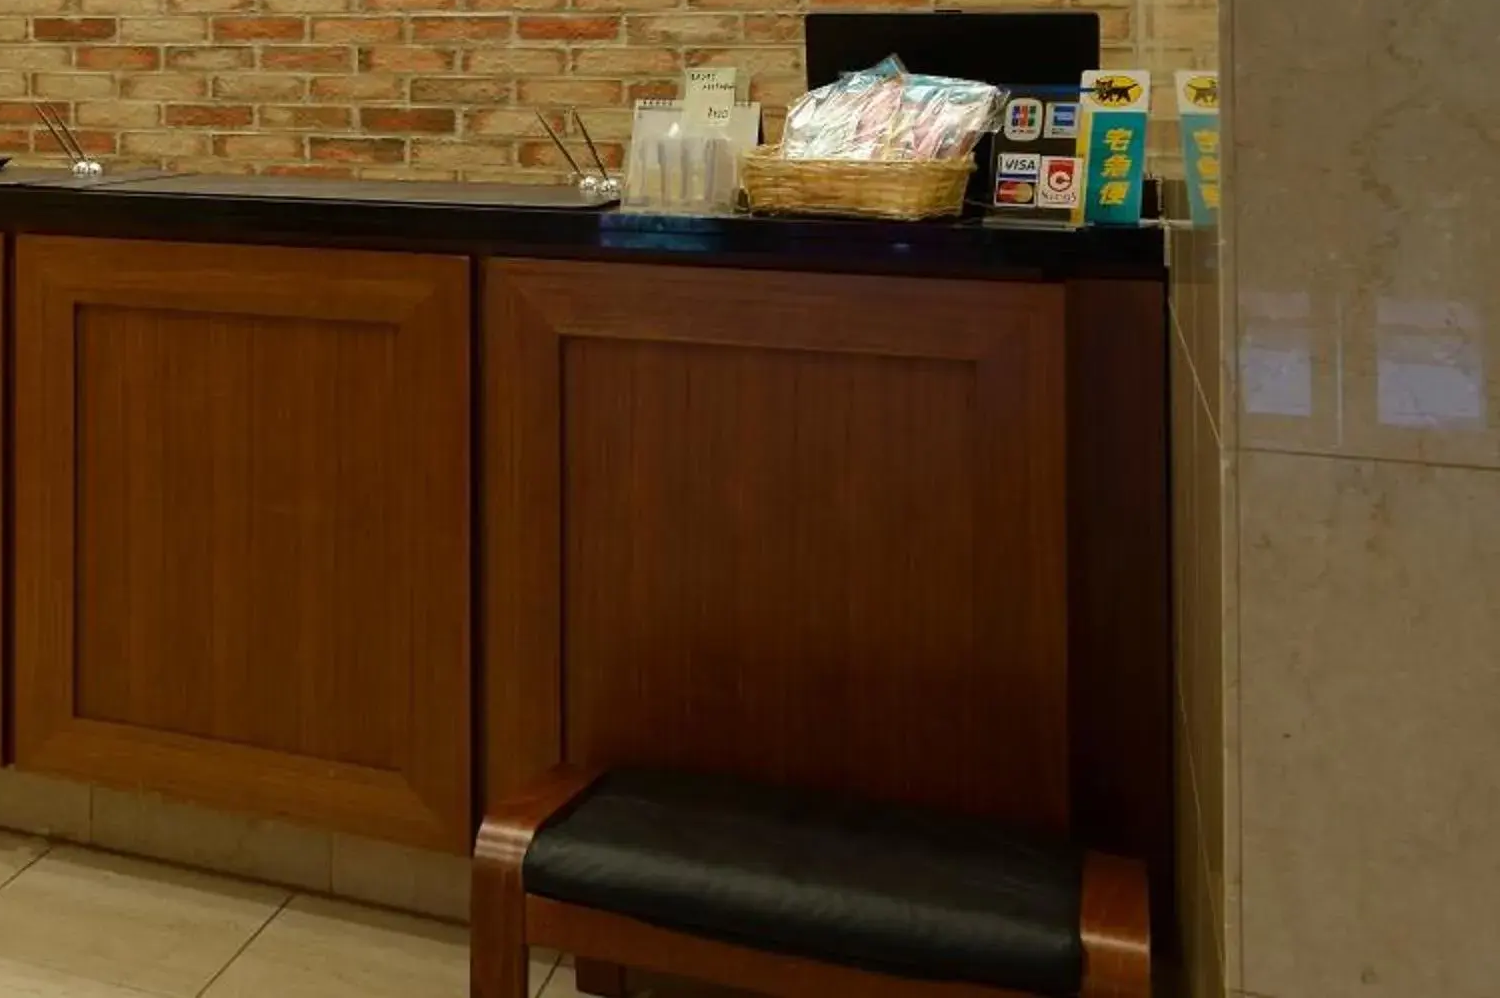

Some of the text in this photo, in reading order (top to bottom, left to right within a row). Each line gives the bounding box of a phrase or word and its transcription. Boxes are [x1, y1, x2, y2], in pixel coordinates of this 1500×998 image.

[1004, 159, 1036, 171] VISA
[1099, 127, 1134, 206] 宅急便
